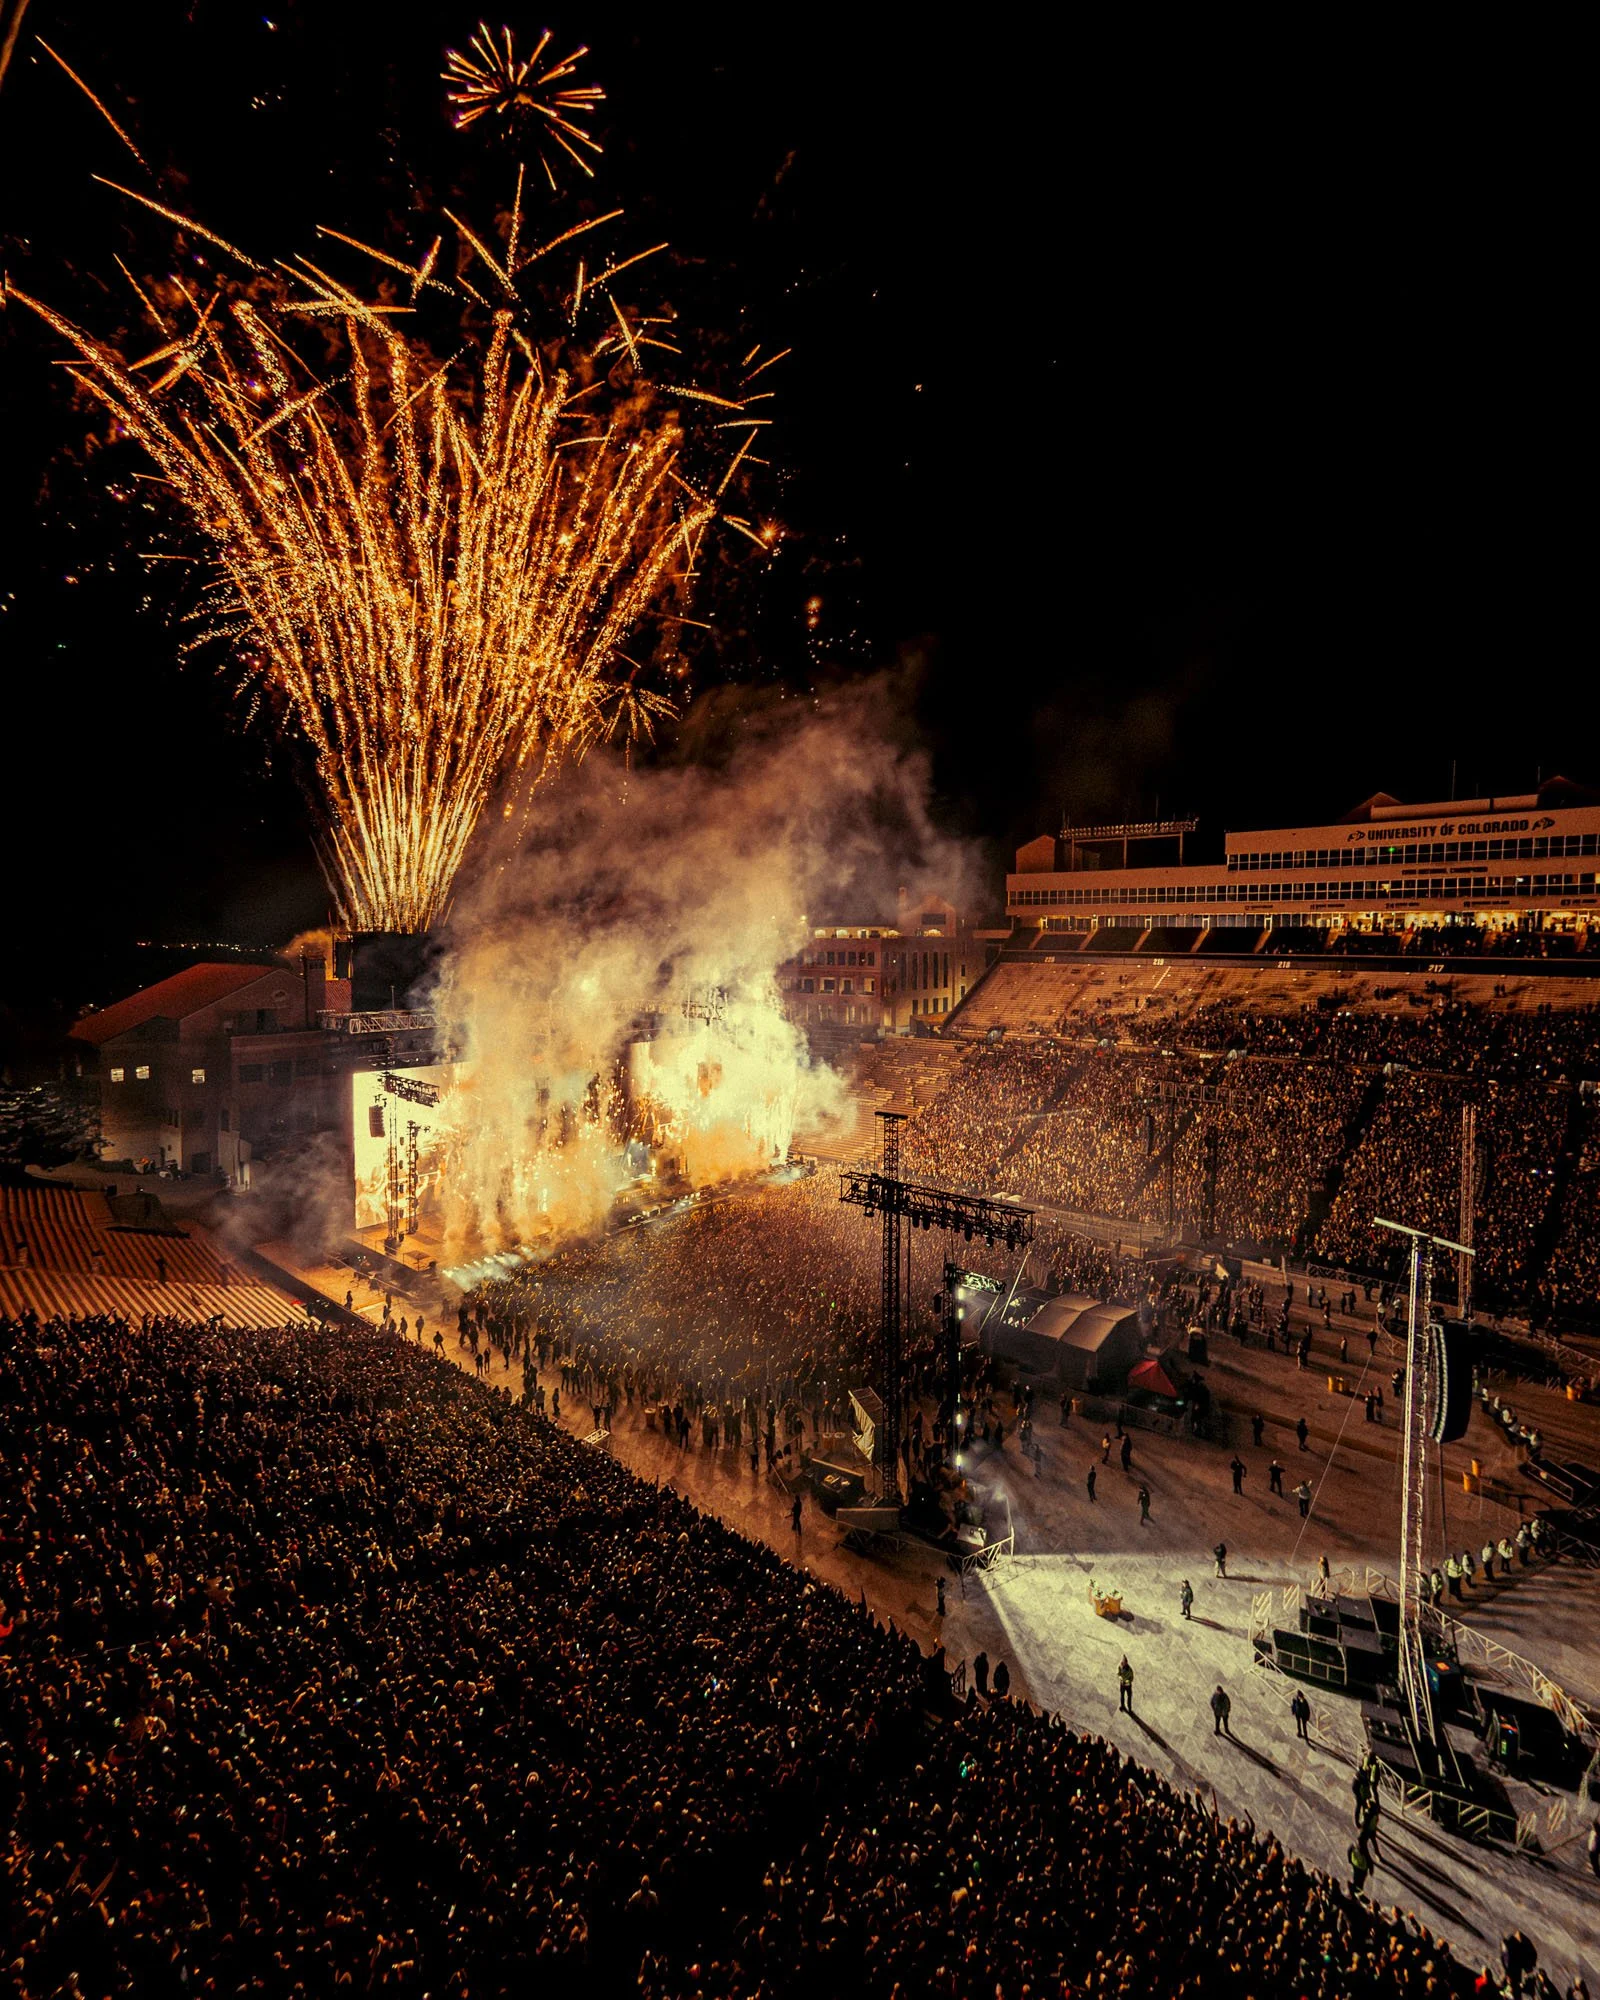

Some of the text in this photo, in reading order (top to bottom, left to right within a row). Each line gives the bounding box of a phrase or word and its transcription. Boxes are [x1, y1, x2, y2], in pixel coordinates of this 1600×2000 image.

[1367, 819, 1529, 841] UNIVERSITY OF COLORADO
[1427, 963, 1445, 973] 217
